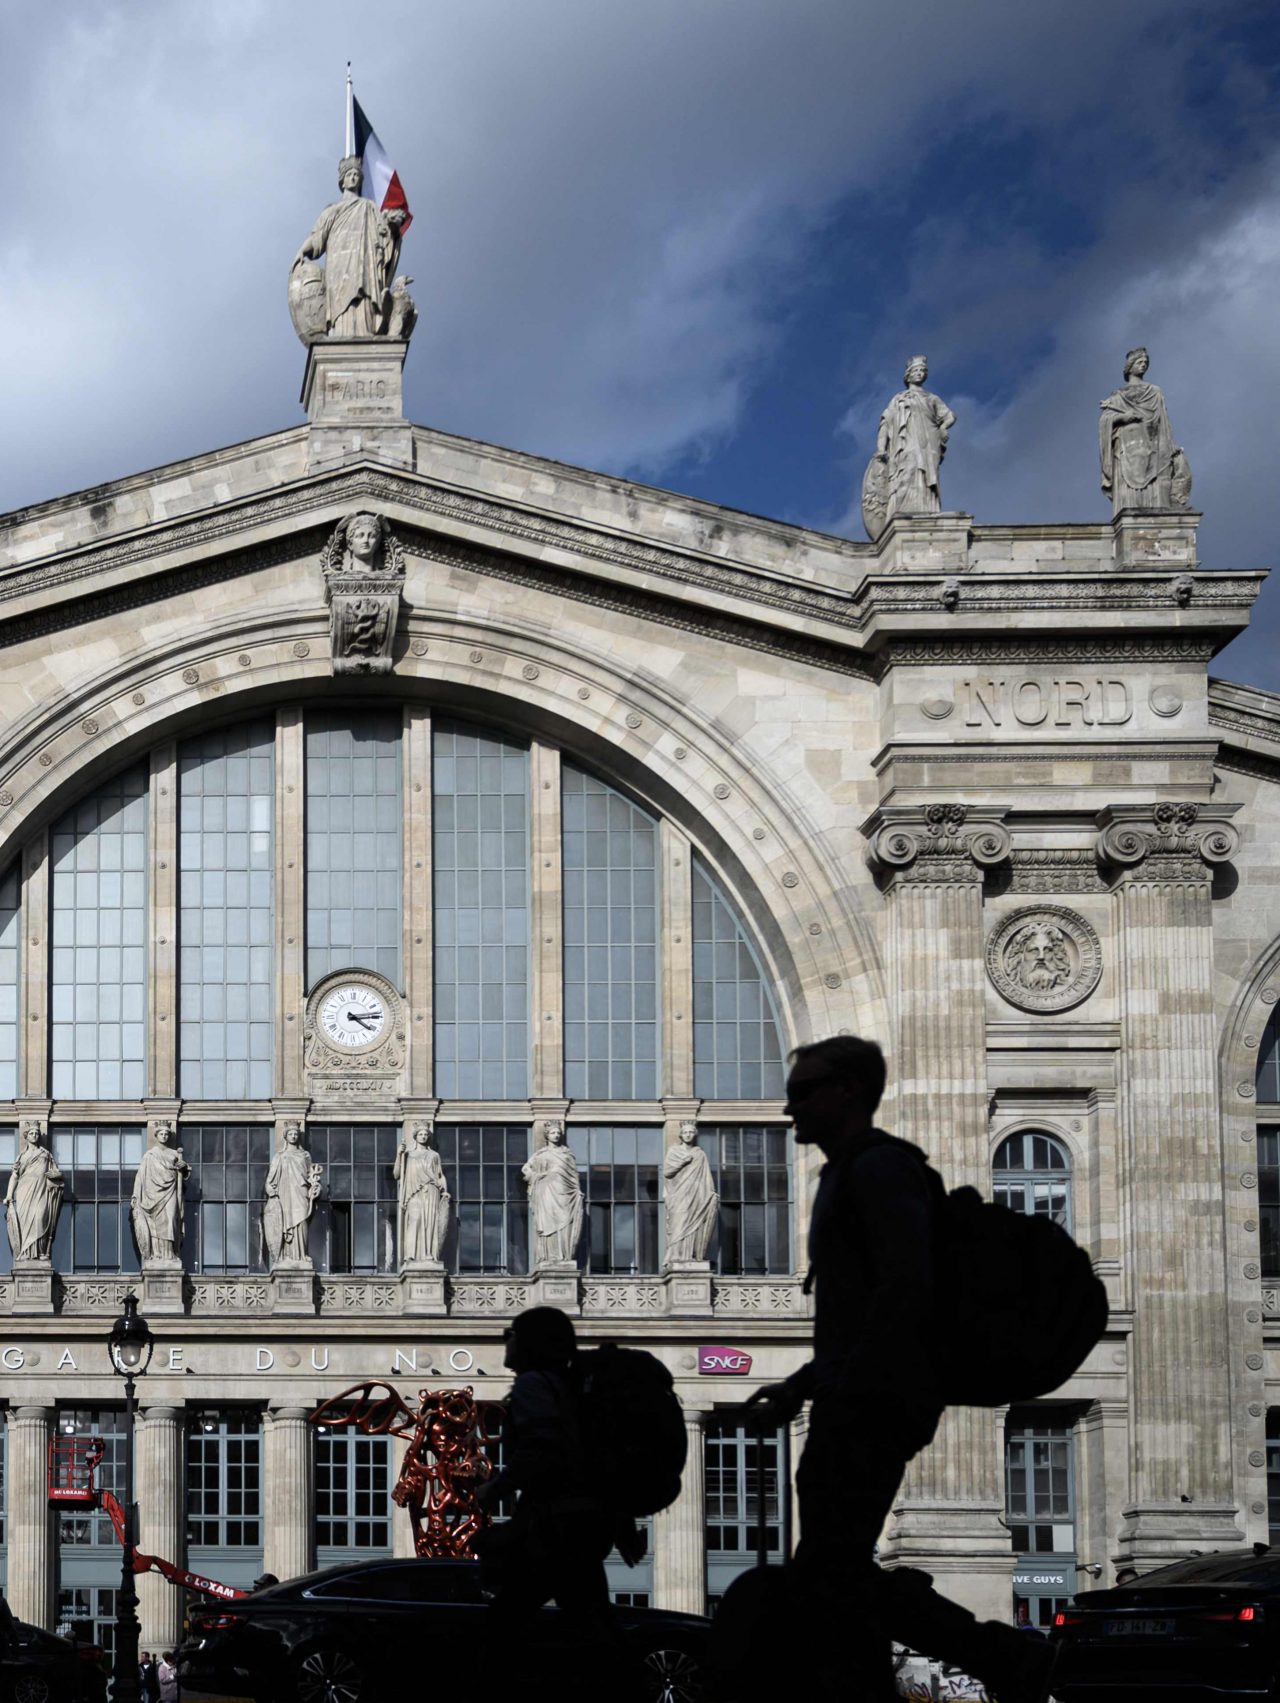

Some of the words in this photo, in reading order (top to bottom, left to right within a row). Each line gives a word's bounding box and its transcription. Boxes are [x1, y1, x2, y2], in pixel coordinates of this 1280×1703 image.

[328, 380, 386, 400] PARIS
[963, 680, 1134, 728] NORD
[256, 1347, 329, 1371] DU
[395, 1348, 474, 1371] NO
[701, 1355, 750, 1369] SNCF
[194, 1578, 235, 1598] LOXAM
[1012, 1575, 1031, 1583] IVE
[1032, 1575, 1064, 1584] GUYS
